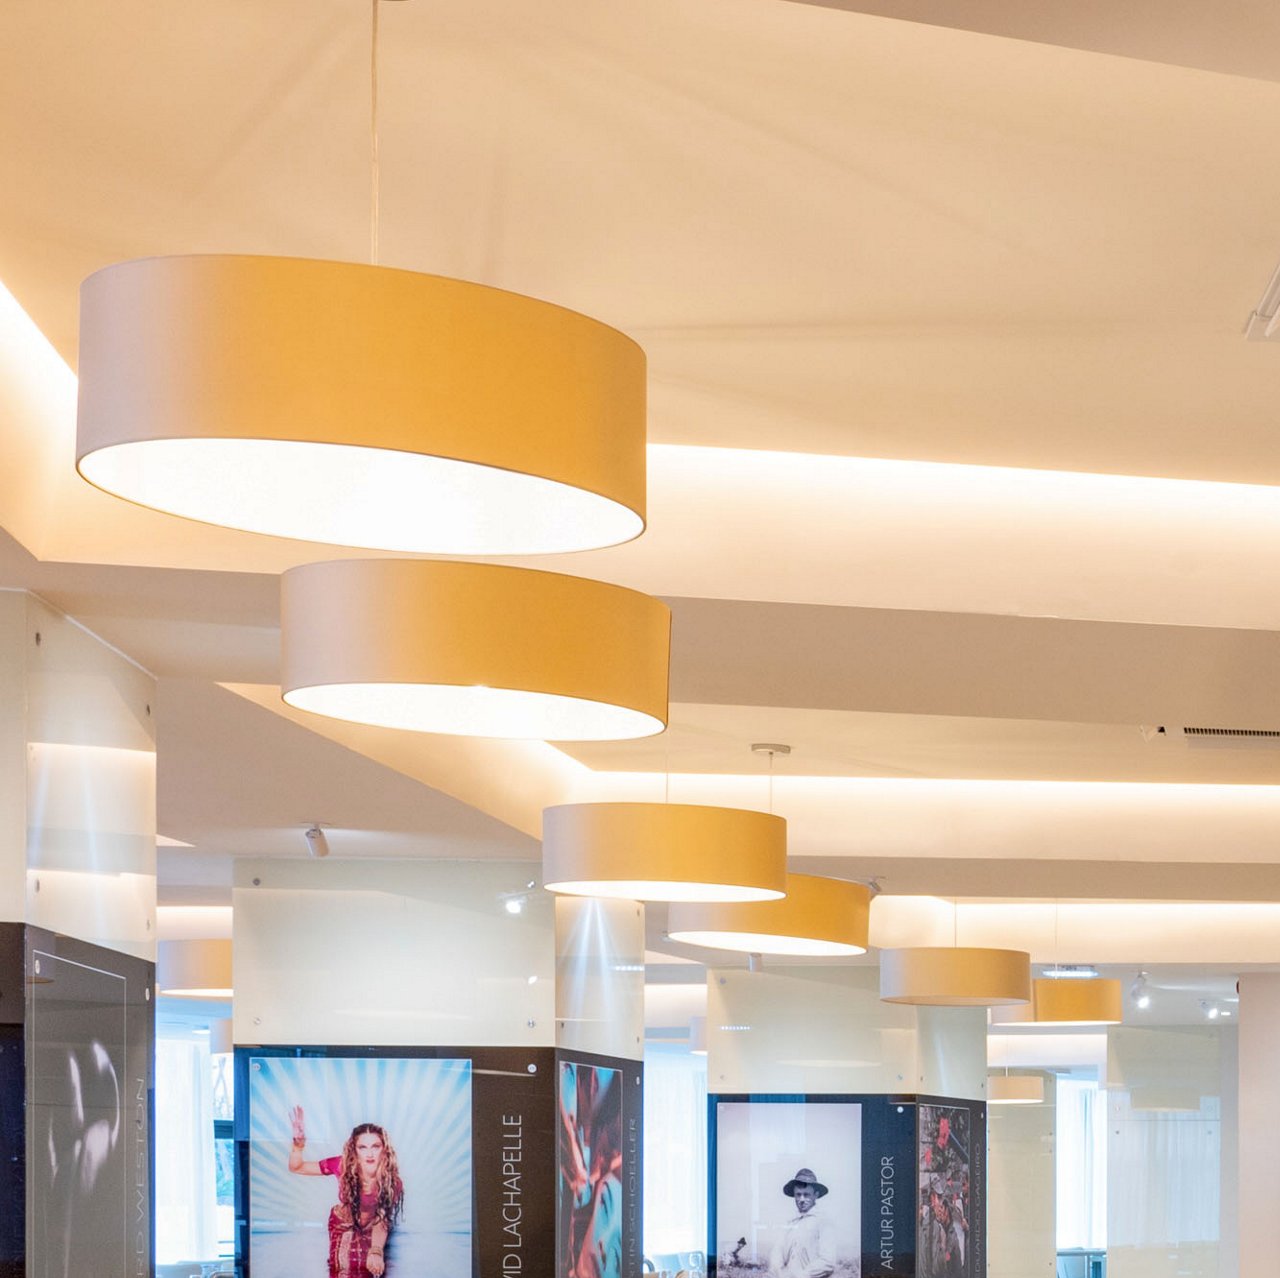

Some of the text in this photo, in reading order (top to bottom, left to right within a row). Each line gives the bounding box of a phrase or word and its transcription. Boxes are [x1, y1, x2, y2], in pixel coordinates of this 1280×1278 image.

[135, 1078, 145, 1222] WESTON
[503, 1114, 522, 1248] LACHAPELLE
[881, 1155, 894, 1270] ARTUR PASTOR
